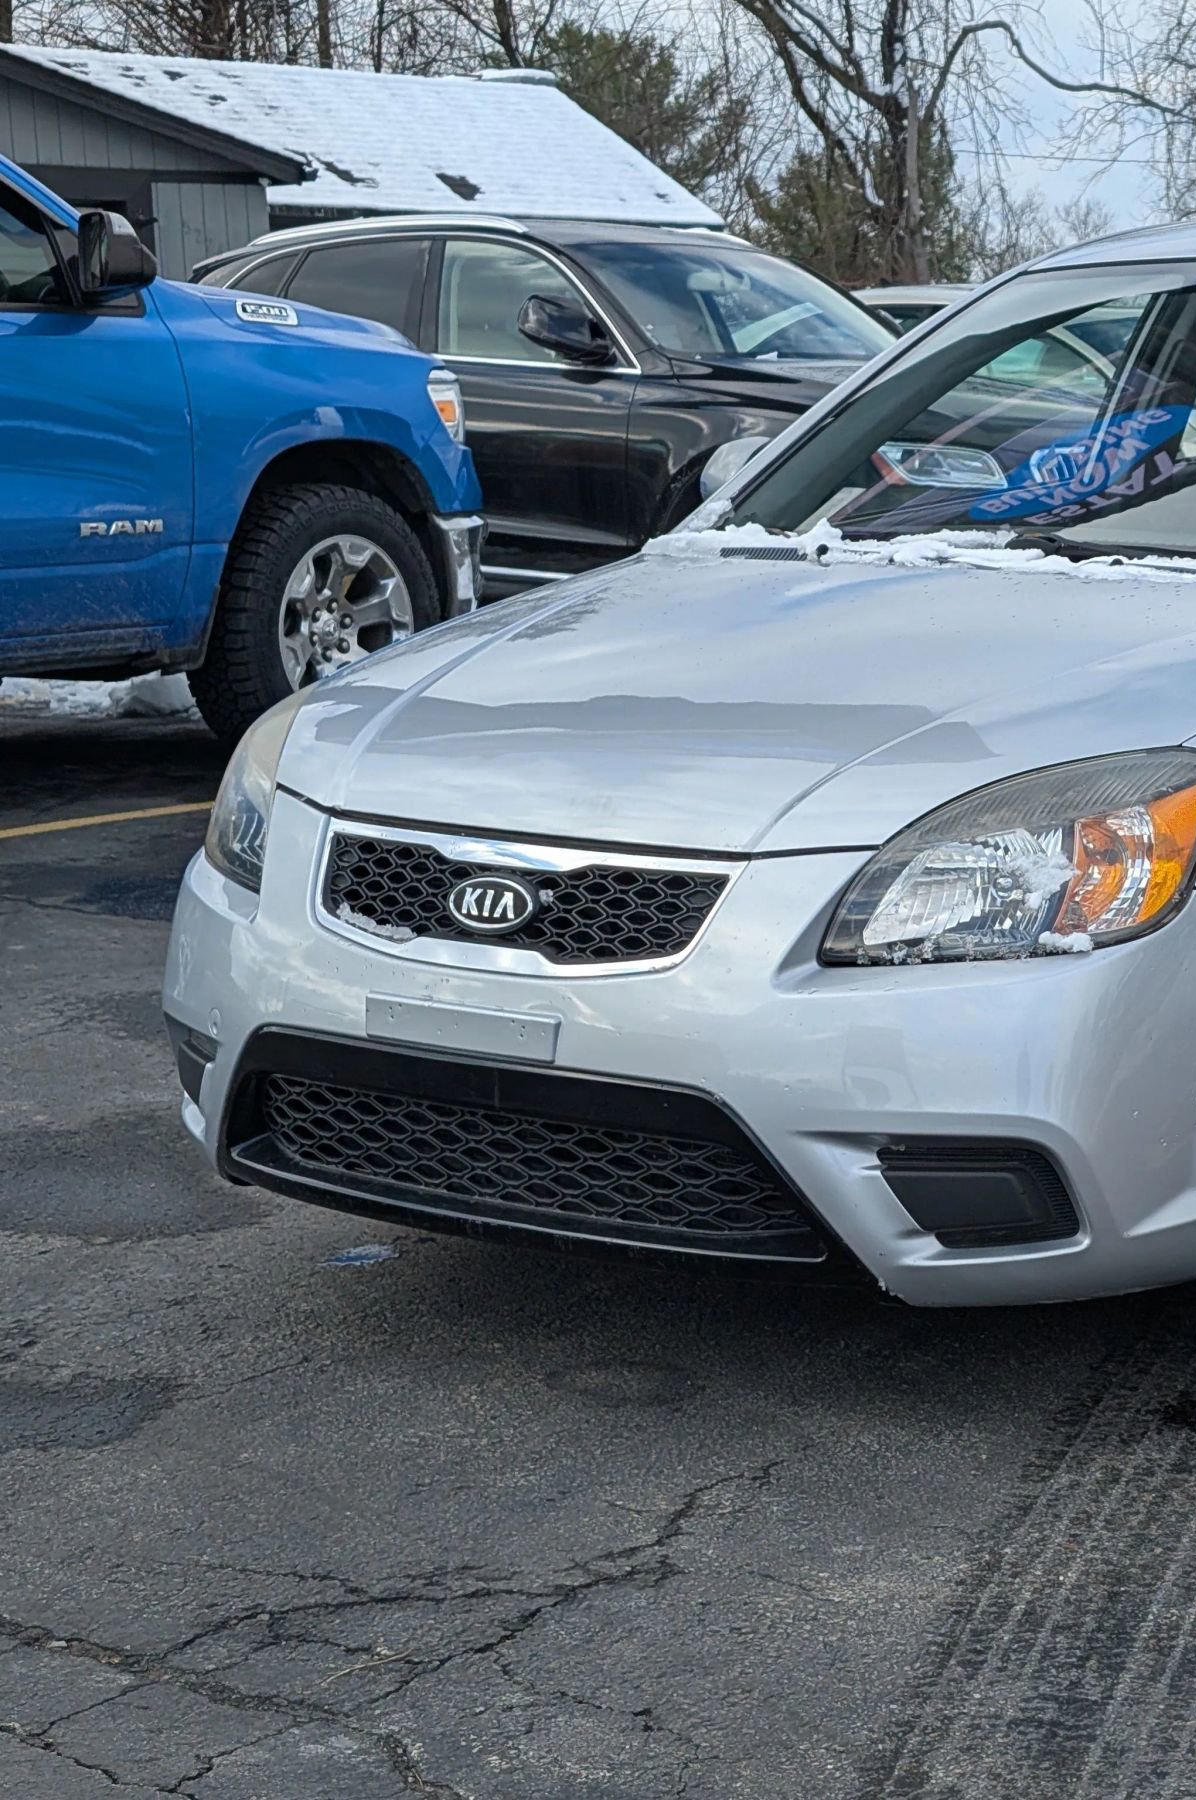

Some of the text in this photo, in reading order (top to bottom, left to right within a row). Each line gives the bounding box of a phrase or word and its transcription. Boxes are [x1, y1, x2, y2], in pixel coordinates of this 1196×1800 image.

[242, 303, 288, 317] 1500
[80, 519, 164, 537] RAM
[461, 887, 515, 919] KIA
